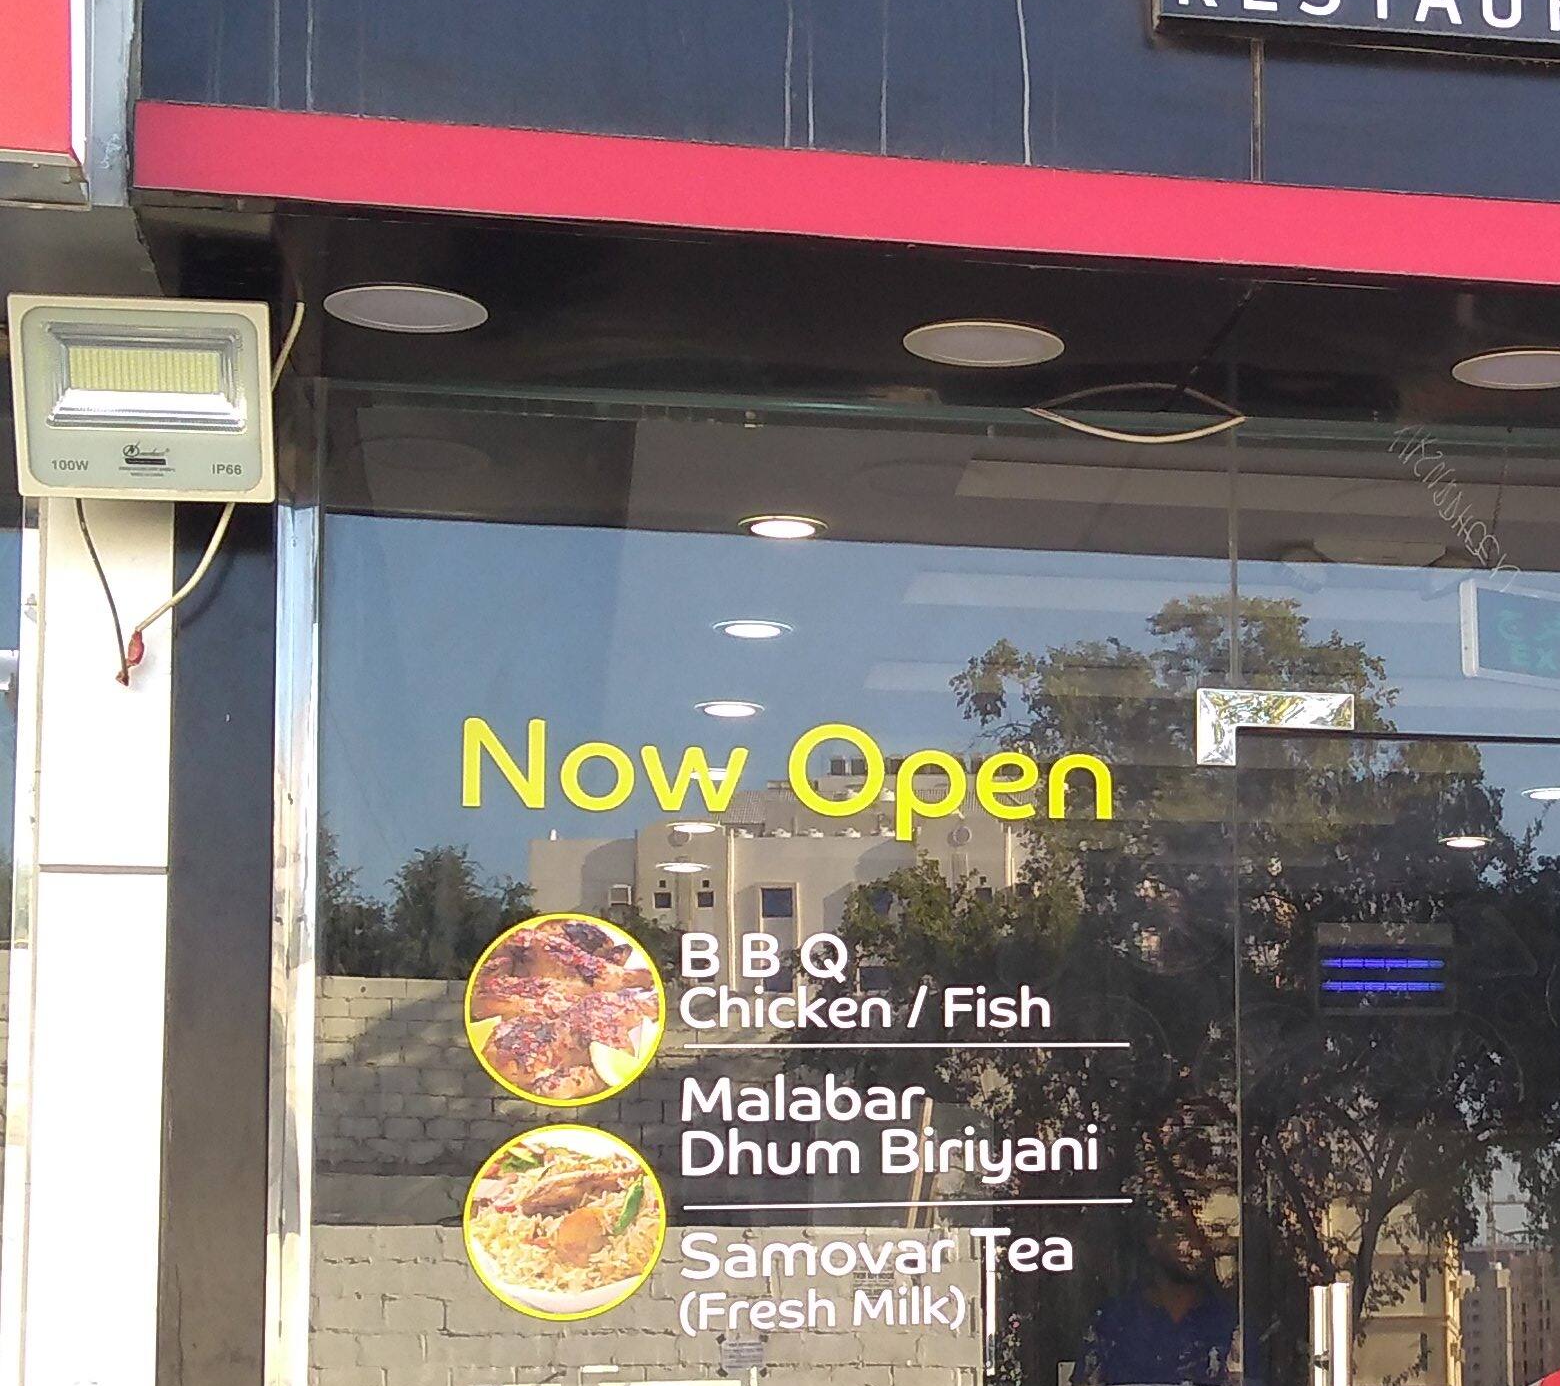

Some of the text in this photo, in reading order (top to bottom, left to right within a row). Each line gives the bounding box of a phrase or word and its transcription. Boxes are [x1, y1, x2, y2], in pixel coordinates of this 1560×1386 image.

[50, 459, 90, 472] 100W
[211, 463, 243, 476] IP66
[462, 717, 1114, 841] Now Open
[679, 986, 893, 1031] Chicken
[943, 986, 1052, 1029] Fish
[681, 1073, 925, 1123] Malabar
[680, 1124, 1099, 1183] Dhum Biriyani
[680, 1228, 1075, 1280] Samovar Tea
[679, 1288, 967, 1337] (Fresh Milk)
